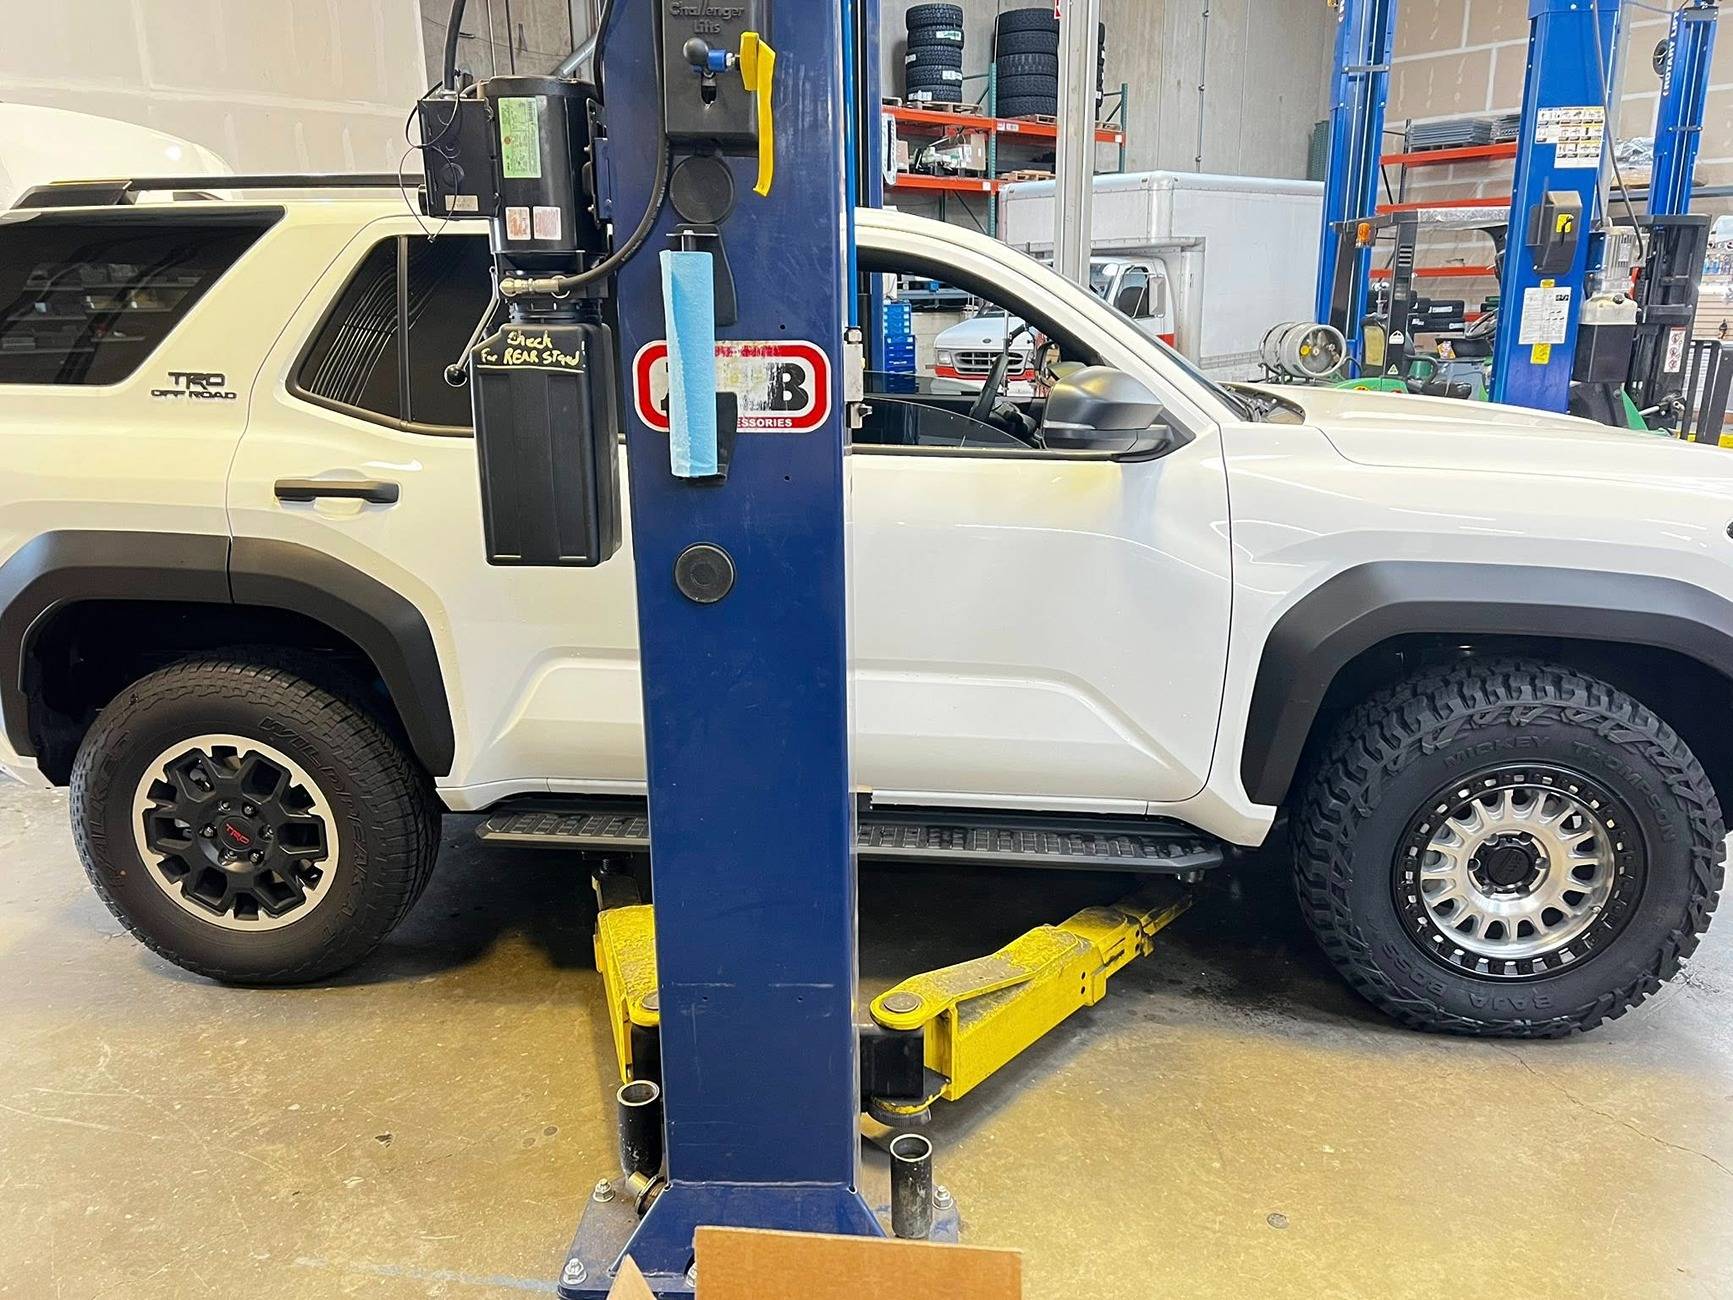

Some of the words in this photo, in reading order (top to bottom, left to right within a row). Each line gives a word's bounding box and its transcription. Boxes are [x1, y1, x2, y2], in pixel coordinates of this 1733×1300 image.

[671, 0, 744, 20] Challenger
[694, 20, 720, 33] Lifts
[1663, 41, 1676, 91] ROTARY
[1670, 11, 1680, 38] LIFT
[503, 347, 539, 365] REAR
[168, 372, 225, 390] TRD
[189, 391, 236, 399] ROAD
[737, 418, 792, 428] ESSORIES
[1443, 735, 1551, 768] MICKEY
[1573, 740, 1677, 842] THOMPSON
[226, 823, 249, 844] TRD
